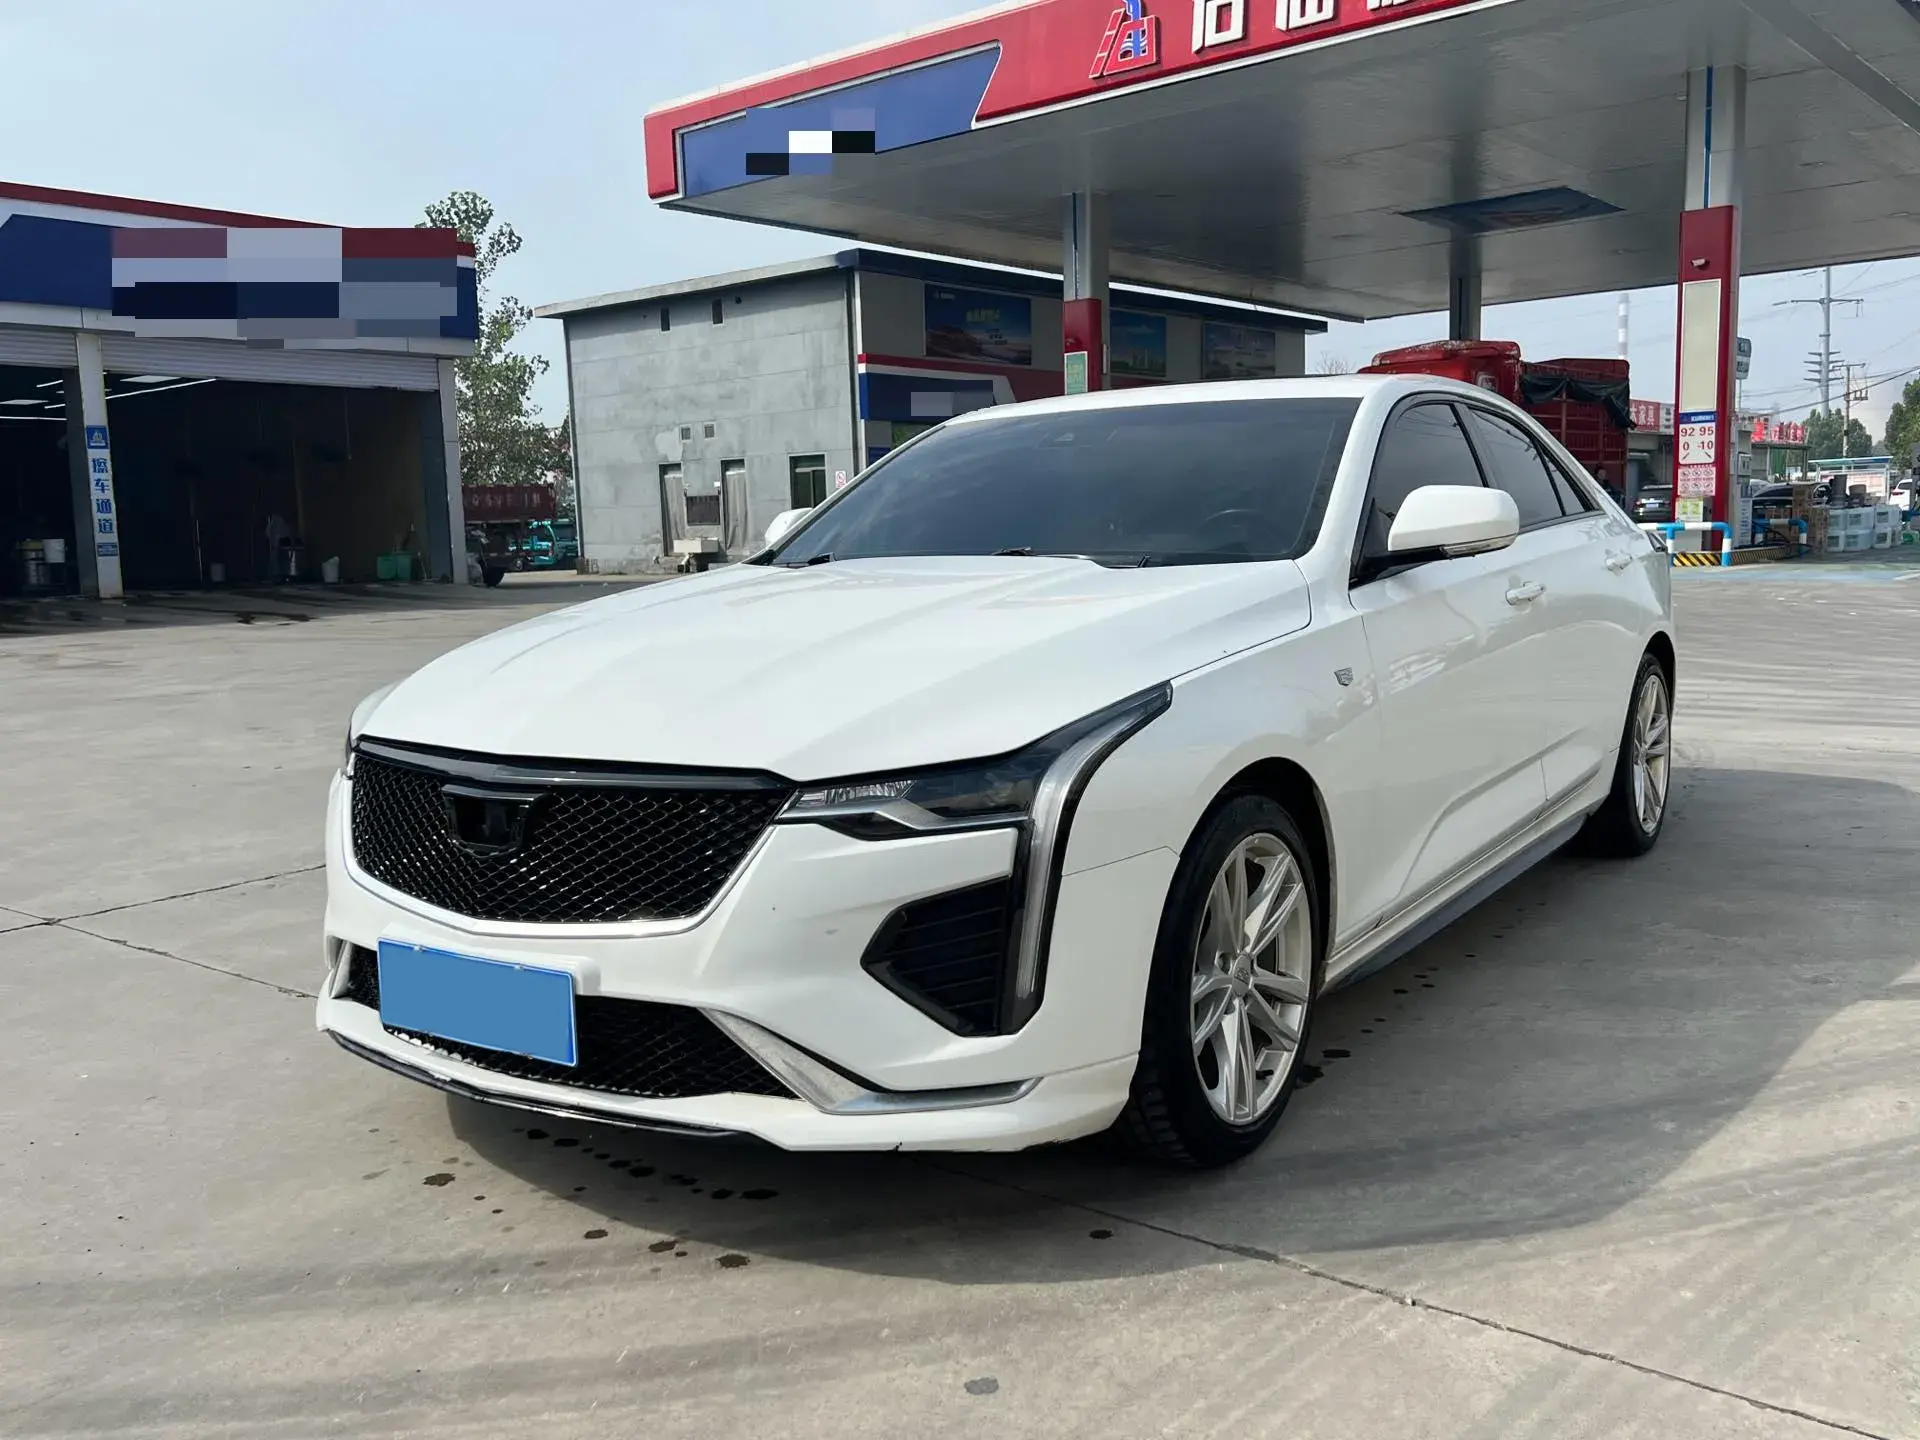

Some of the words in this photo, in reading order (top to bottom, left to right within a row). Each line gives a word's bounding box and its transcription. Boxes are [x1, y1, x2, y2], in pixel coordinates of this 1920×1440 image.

[1681, 427, 1695, 437] 92
[1699, 426, 1714, 436] 95
[1682, 441, 1690, 451] 0
[1697, 440, 1714, 450] -10
